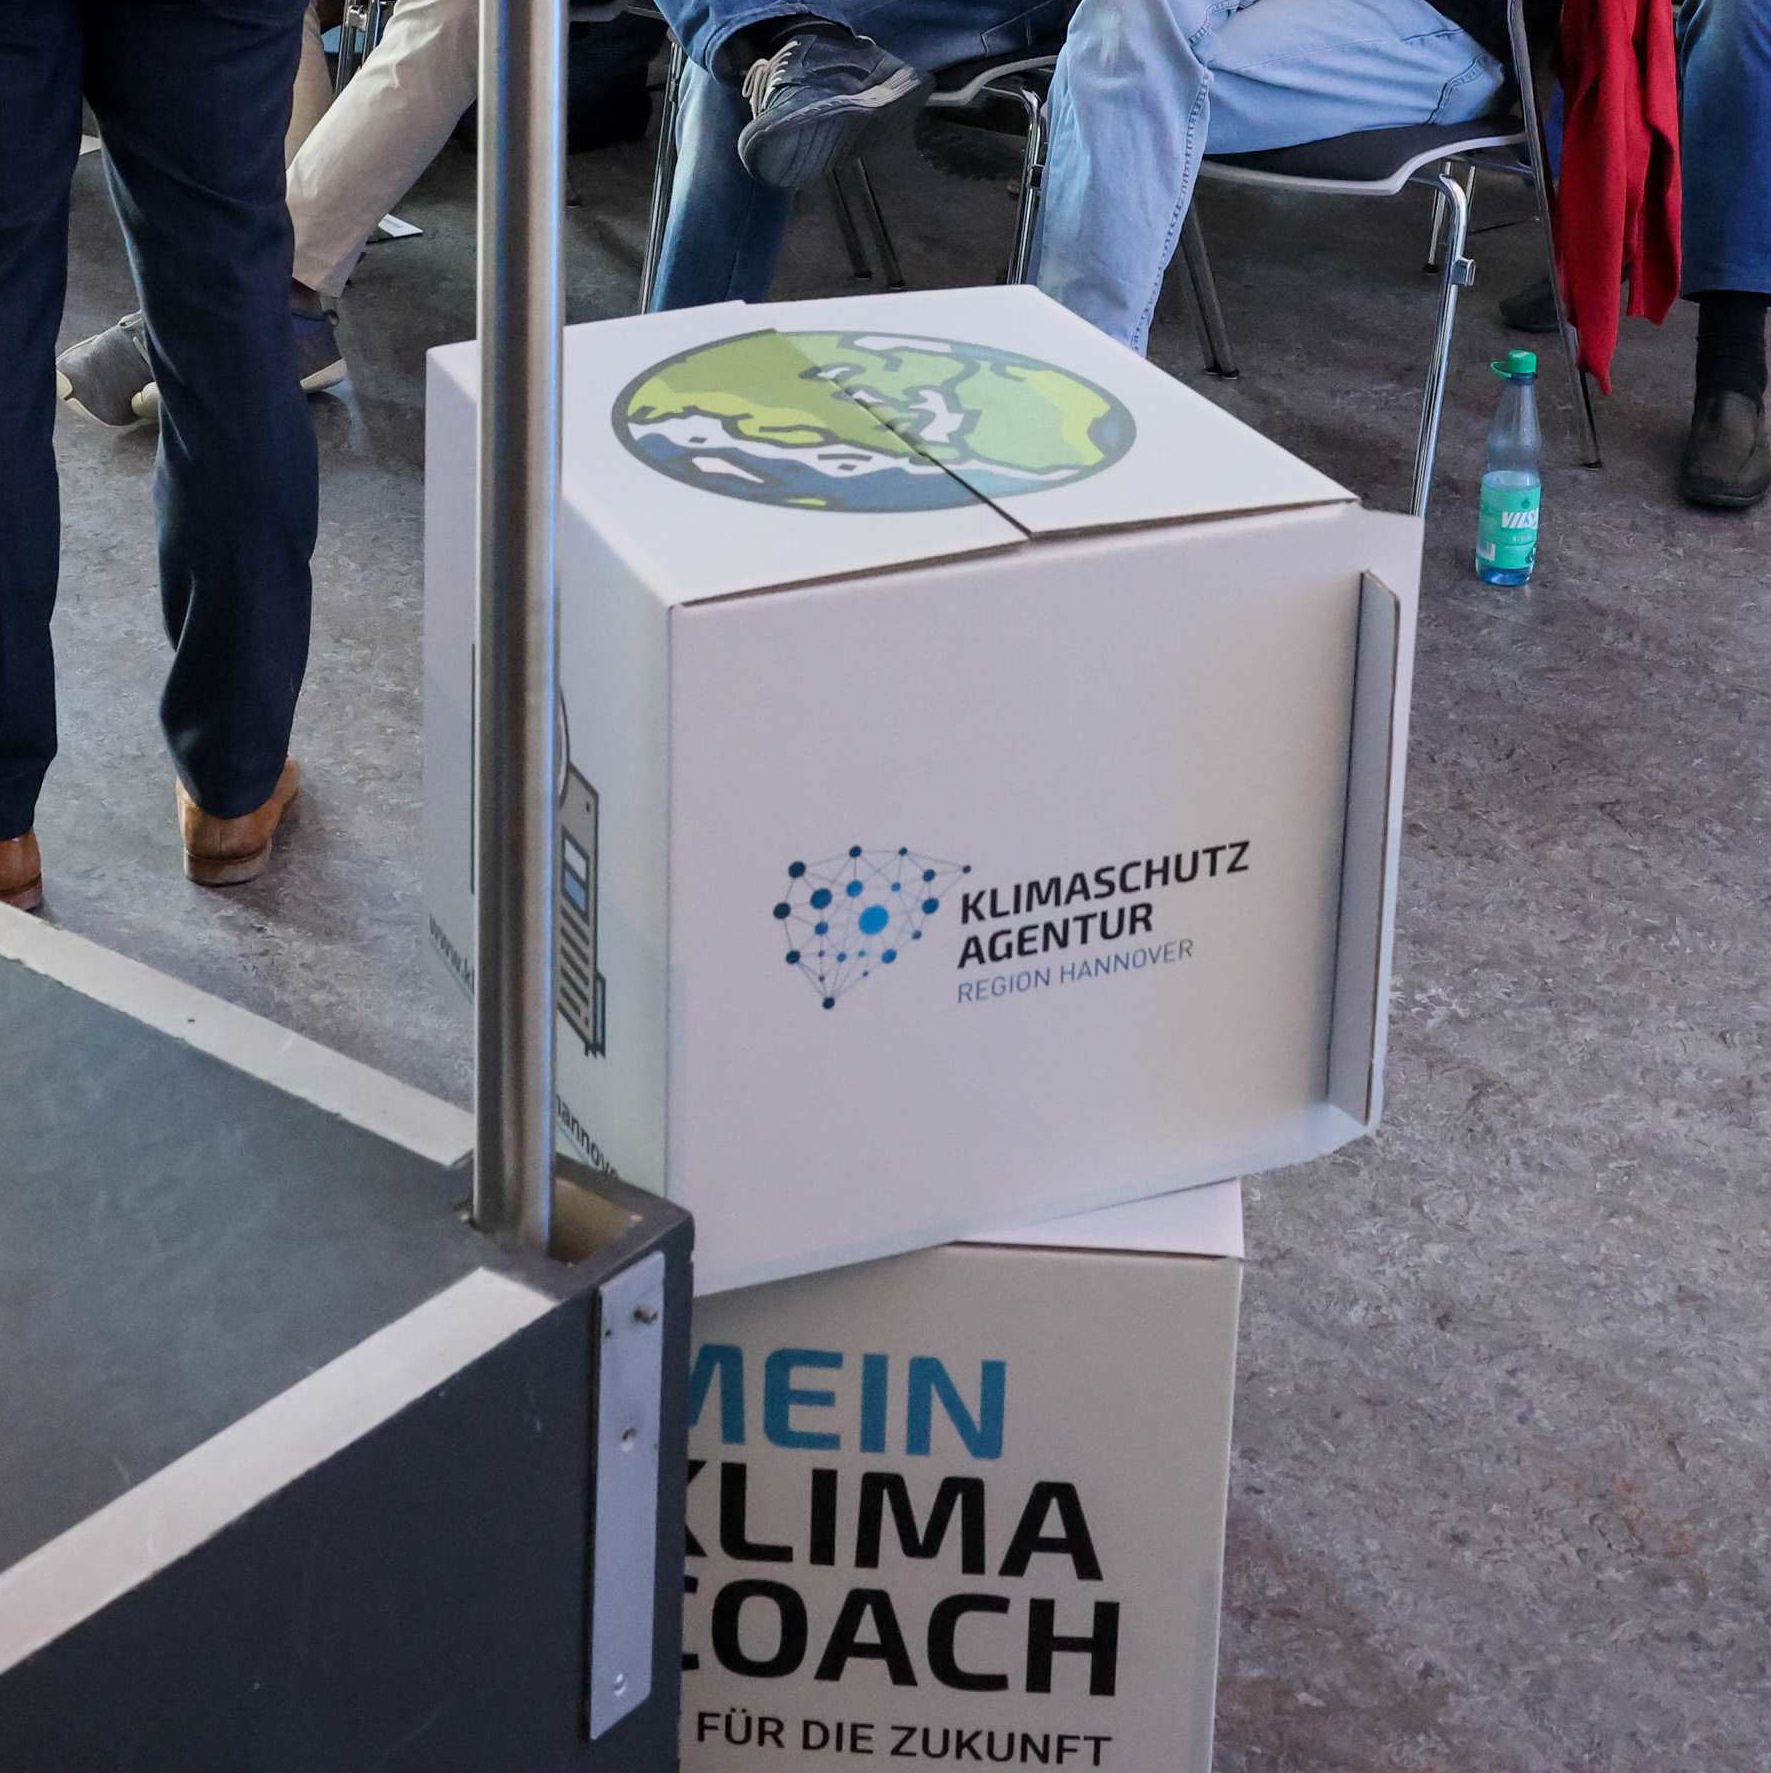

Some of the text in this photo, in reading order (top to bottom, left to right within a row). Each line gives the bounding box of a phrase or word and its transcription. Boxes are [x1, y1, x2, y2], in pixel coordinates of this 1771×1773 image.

[961, 840, 1250, 925] KLIMASCHUTZ
[957, 902, 1153, 969] AGENTUR
[958, 938, 1194, 1003] REGION HANNOVER
[682, 1575, 1120, 1697] OACH
[697, 1707, 1113, 1767] FÜR DIE ZUKUNFT
